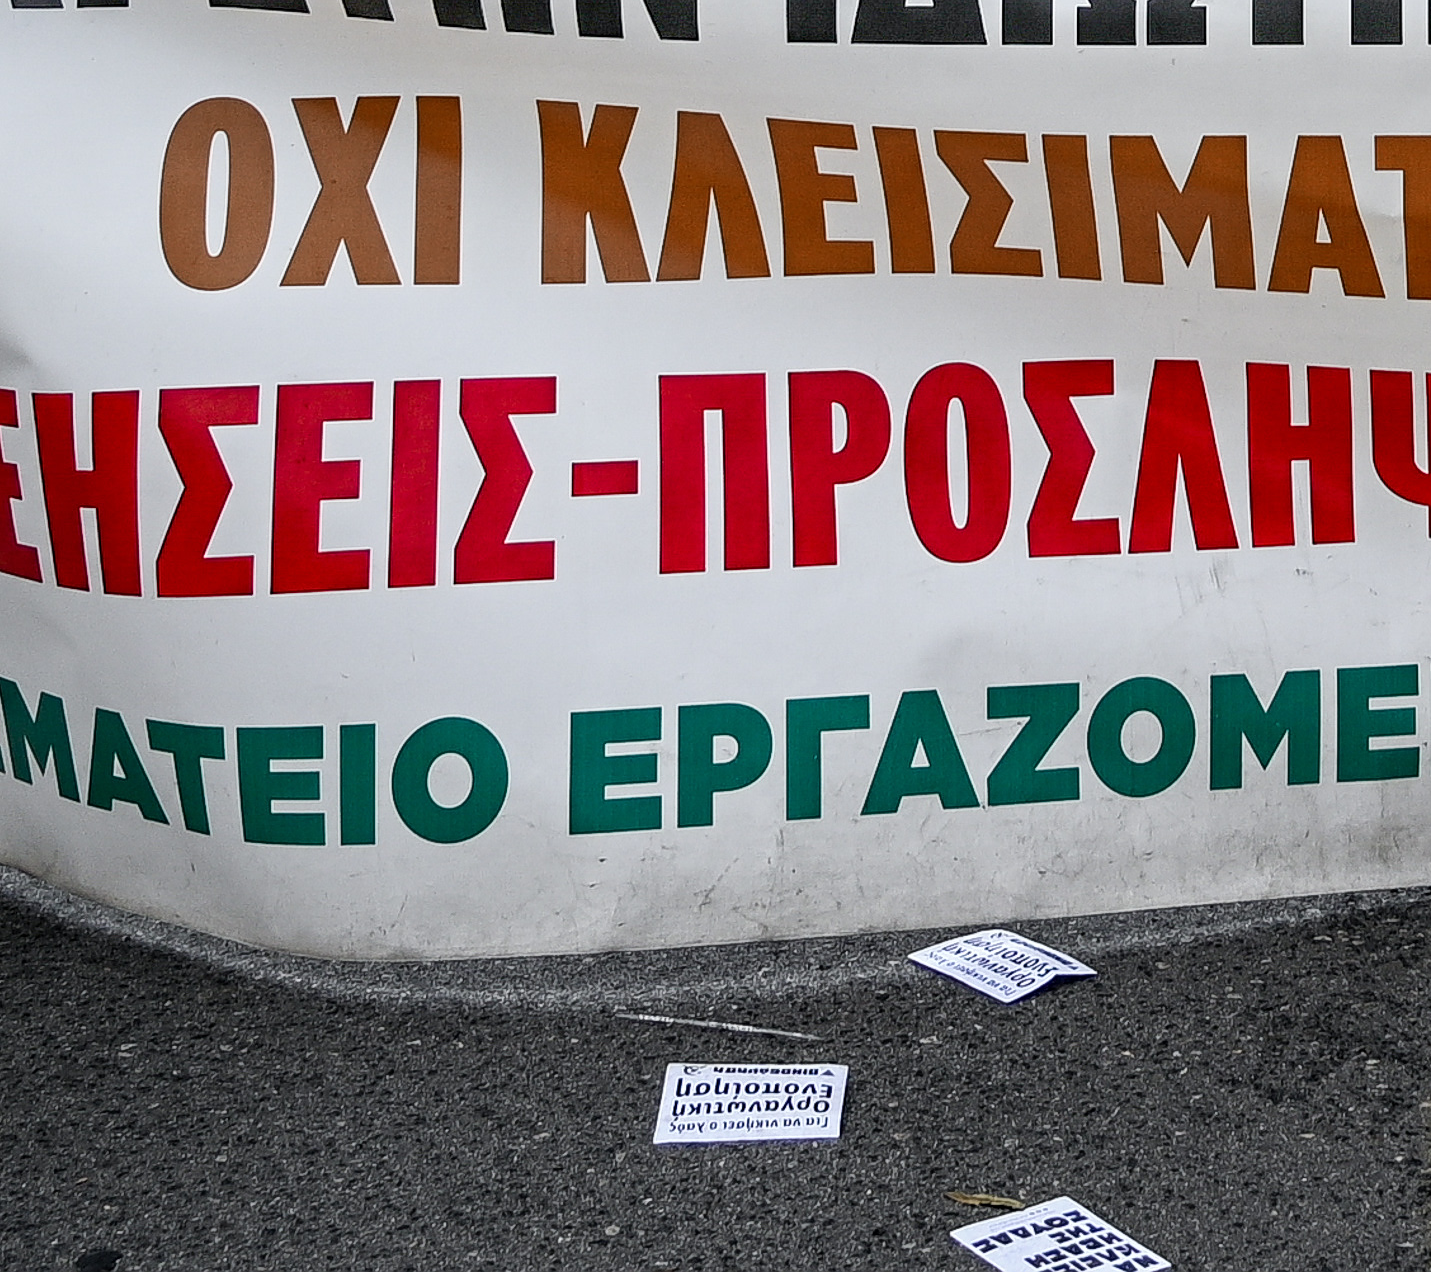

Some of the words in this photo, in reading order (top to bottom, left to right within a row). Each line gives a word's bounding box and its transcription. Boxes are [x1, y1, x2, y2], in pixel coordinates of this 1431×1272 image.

[158, 94, 462, 292] ΟΧΙ
[676, 1078, 833, 1100] Ενοποίηση
[672, 1096, 830, 1121] Οργανωτική
[669, 1120, 705, 1133] λαός
[710, 1121, 717, 1129] ο
[723, 1116, 778, 1132] νικήσει
[783, 1116, 801, 1127] να
[807, 1116, 828, 1128] Για
[972, 1210, 1088, 1253] ΣΟΥΔΑΣ
[1049, 1223, 1105, 1244] ΤΗΣ
